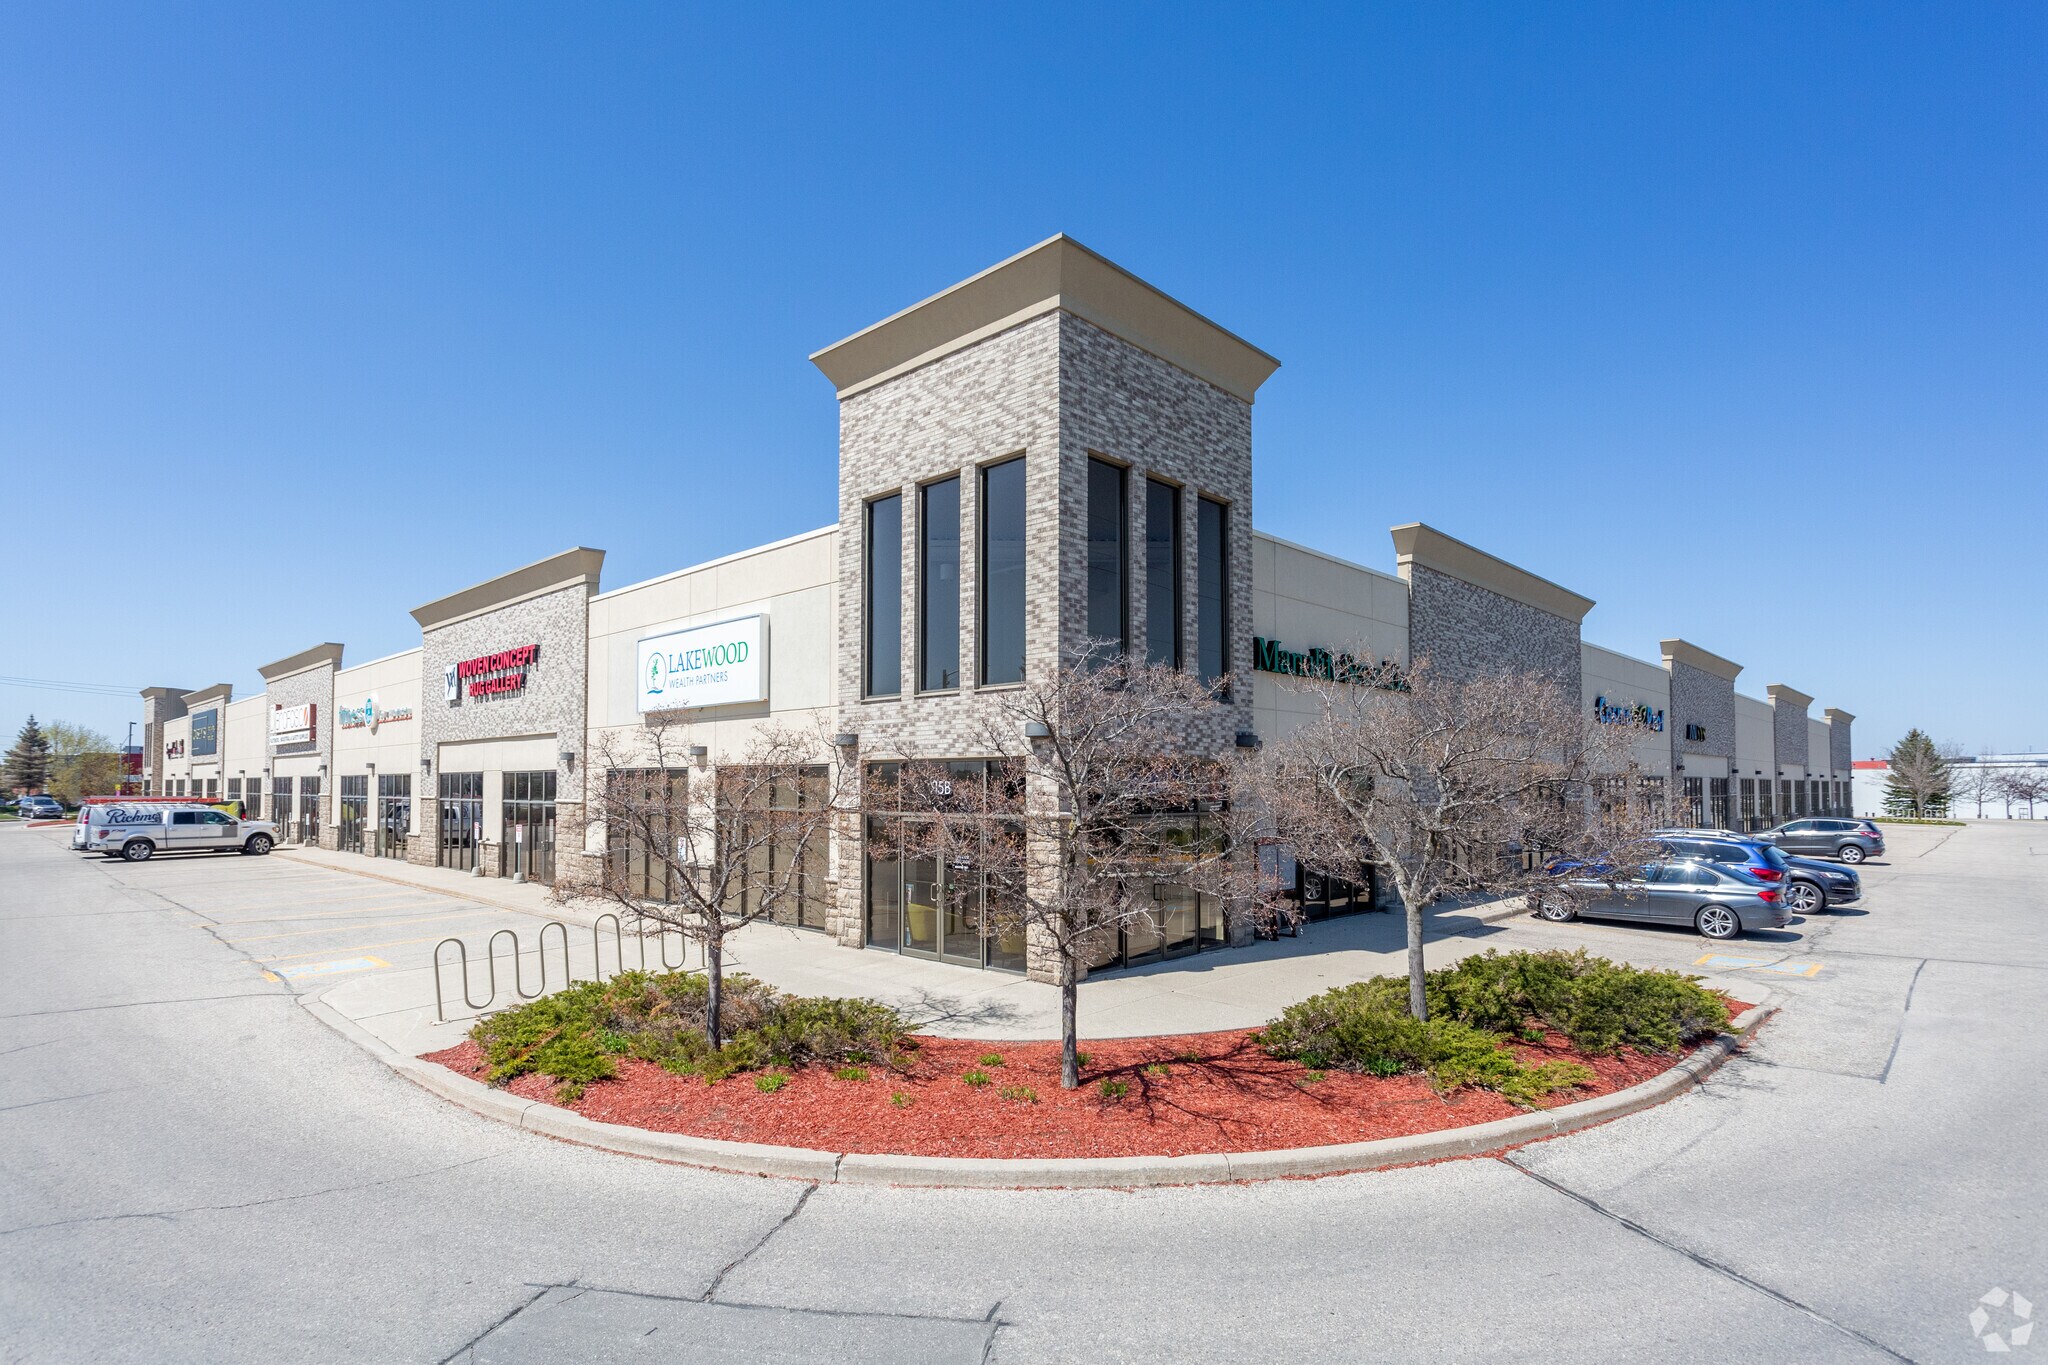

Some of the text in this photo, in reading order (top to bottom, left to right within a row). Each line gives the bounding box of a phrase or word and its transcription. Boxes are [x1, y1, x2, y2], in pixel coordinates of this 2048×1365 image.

[458, 644, 536, 678] WOVEN CONCEPT
[669, 641, 749, 673] LAKEWOOD
[469, 673, 523, 697] RUG GALLERY
[669, 671, 729, 689] WEALTH PARTNERS
